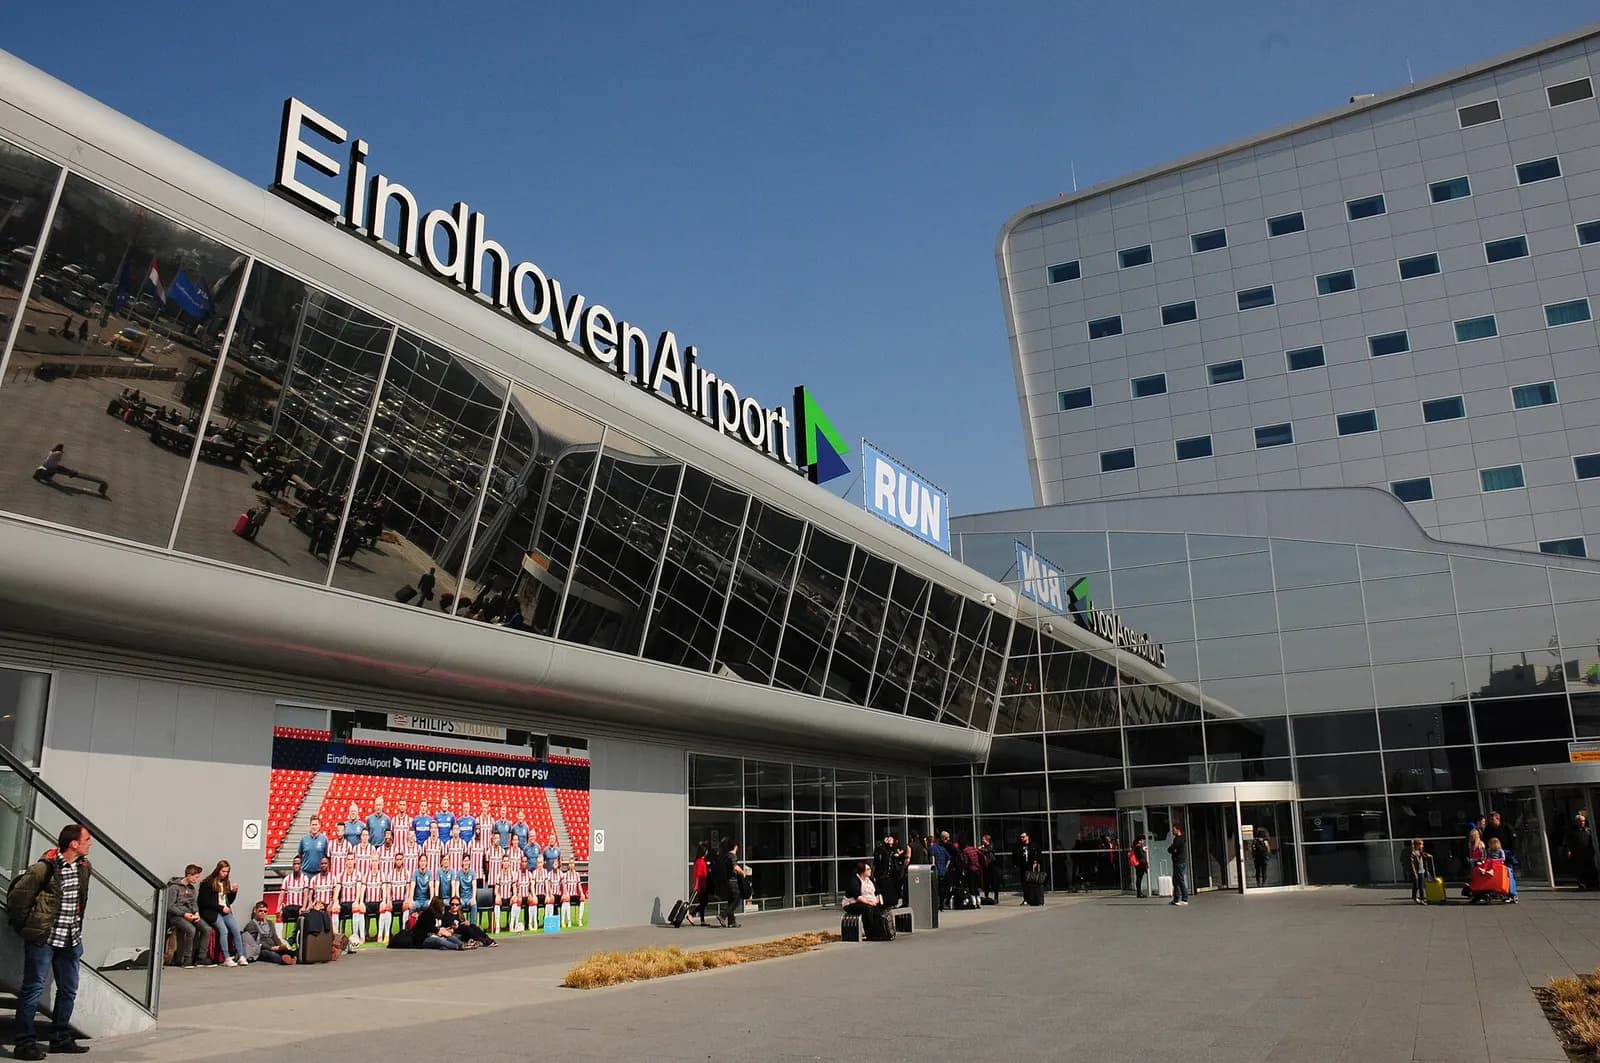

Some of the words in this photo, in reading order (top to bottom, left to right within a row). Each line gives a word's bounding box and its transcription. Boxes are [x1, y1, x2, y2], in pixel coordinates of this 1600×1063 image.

[275, 97, 792, 464] EindhovenAirport
[874, 458, 941, 542] RUN
[404, 758, 427, 771] THE
[428, 760, 474, 775] OFFICIAL
[475, 764, 517, 778] AIRPORT
[517, 767, 531, 779] OF
[531, 769, 549, 781] PSV
